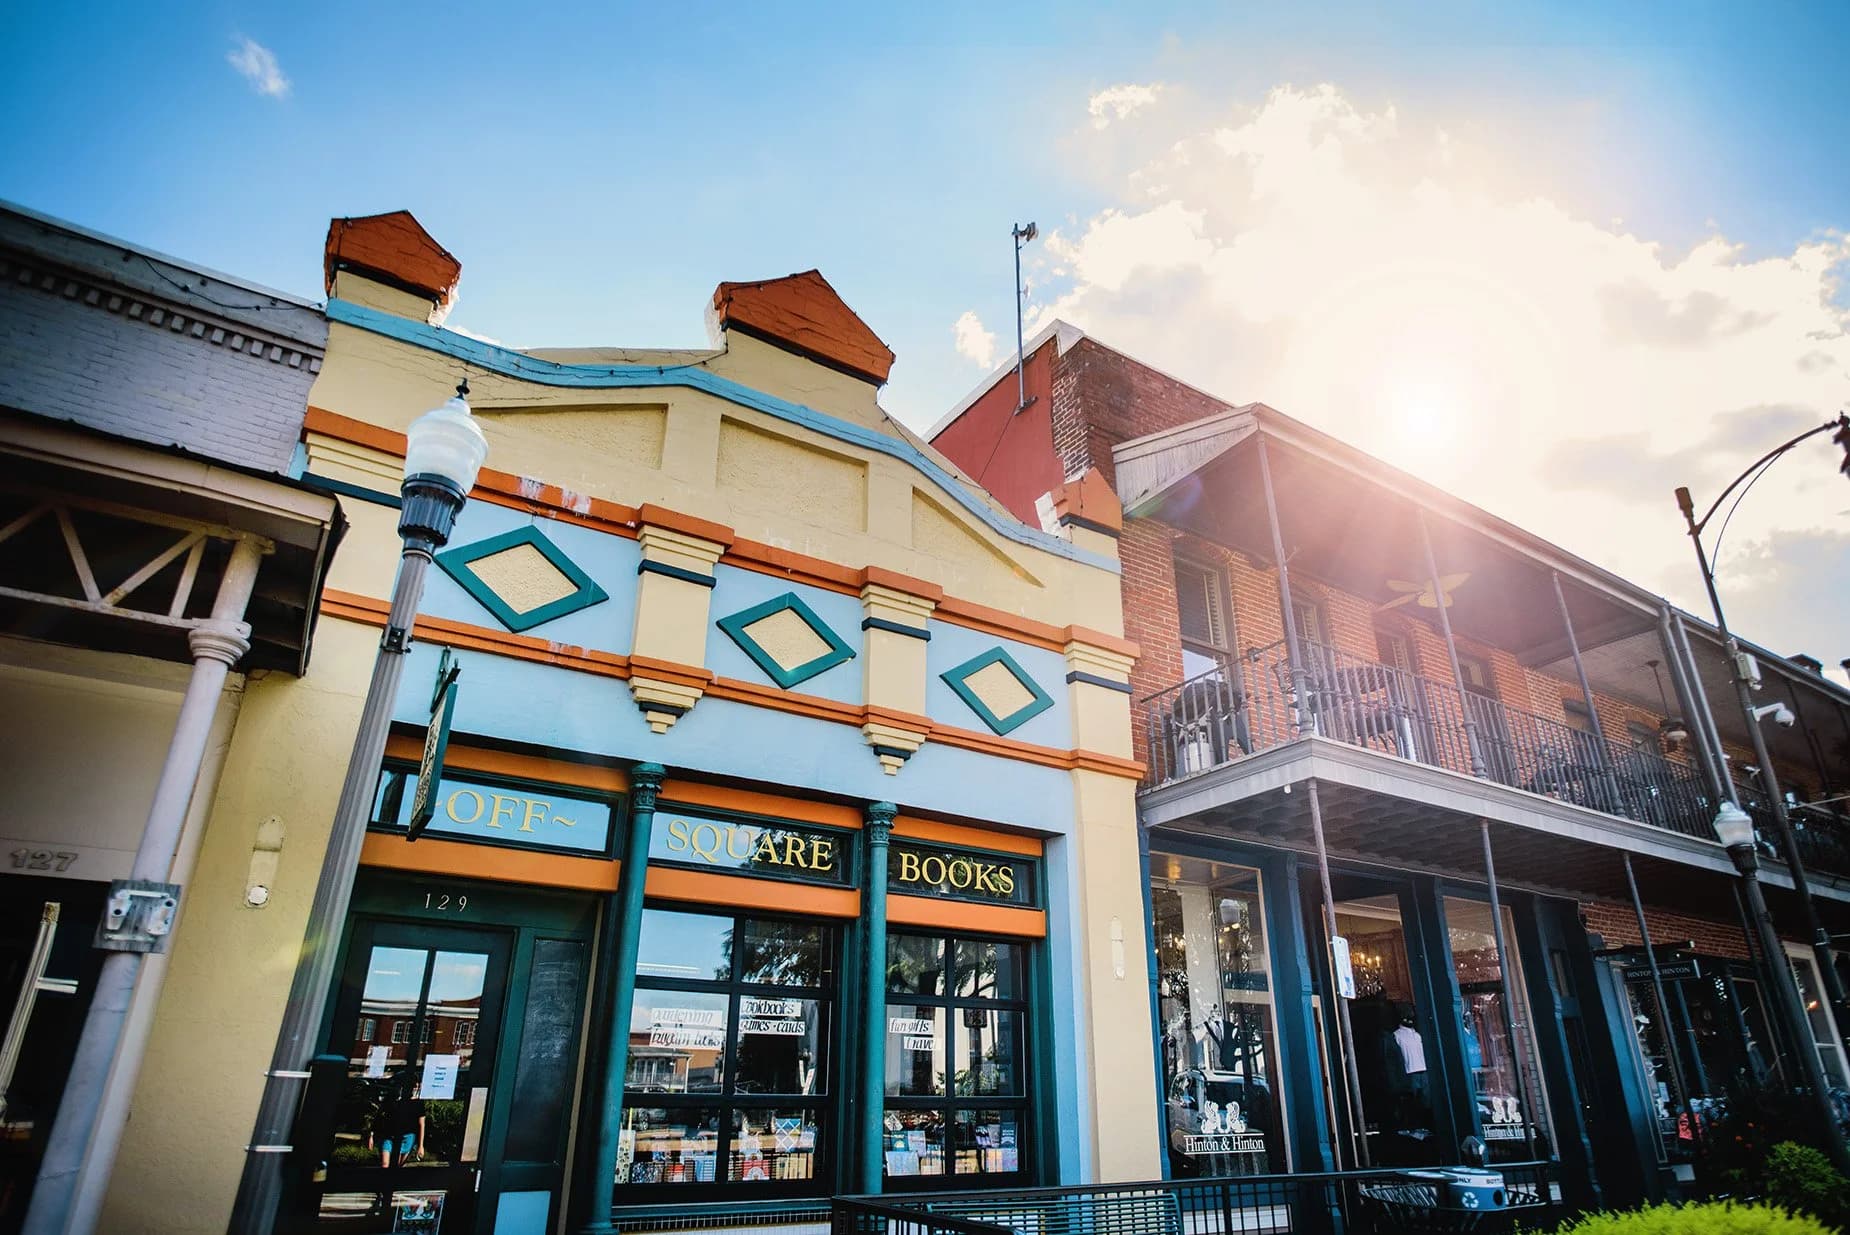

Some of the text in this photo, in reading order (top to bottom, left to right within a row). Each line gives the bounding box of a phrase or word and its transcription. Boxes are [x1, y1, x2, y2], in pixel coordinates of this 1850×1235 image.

[666, 818, 833, 872] SQUARE
[10, 848, 79, 872] 127
[898, 852, 1014, 895] BOOKS
[425, 893, 467, 912] 129
[1185, 1135, 1264, 1152] Hinton & Hinton
